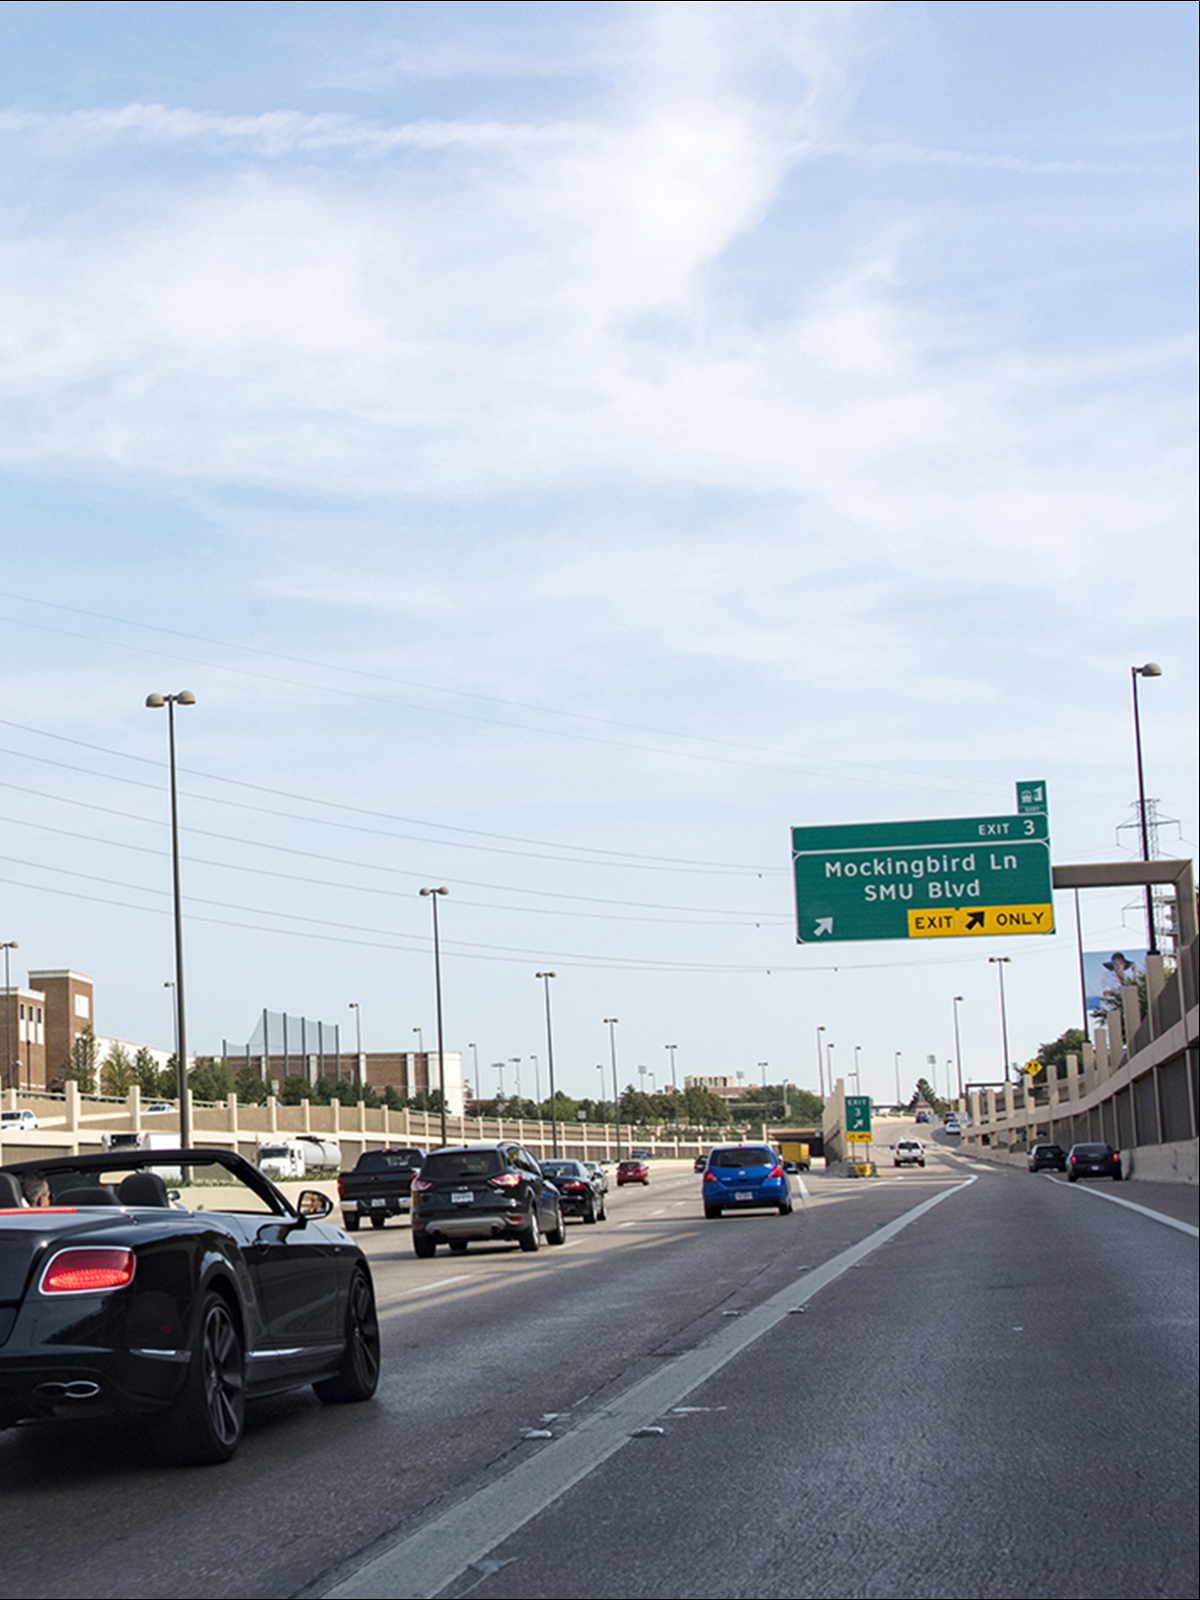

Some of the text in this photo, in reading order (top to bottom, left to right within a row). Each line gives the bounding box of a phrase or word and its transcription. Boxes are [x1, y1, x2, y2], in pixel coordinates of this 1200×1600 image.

[978, 819, 1036, 836] EXIT 3
[825, 853, 1018, 878] Mockingbird Ln
[864, 878, 981, 902] SMU Blvd
[915, 911, 1045, 930] EXIT ONLY
[854, 1107, 862, 1117] 3
